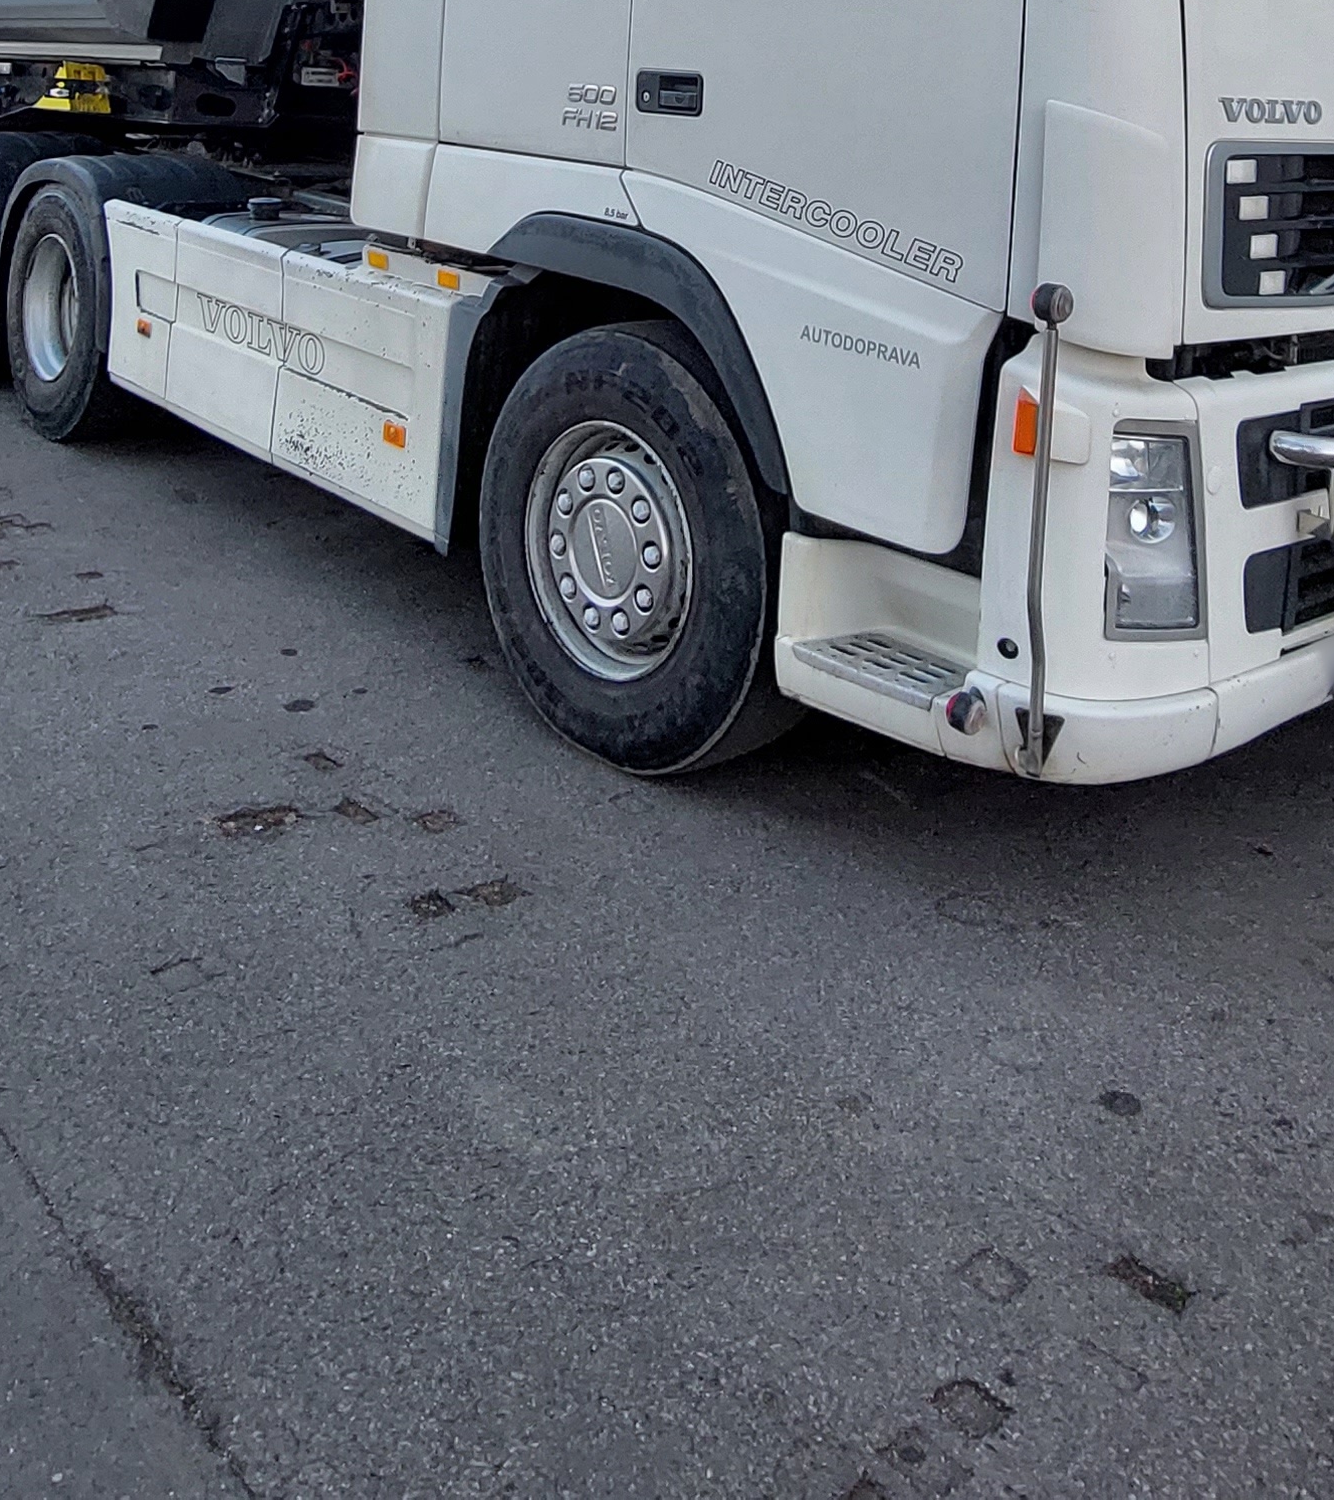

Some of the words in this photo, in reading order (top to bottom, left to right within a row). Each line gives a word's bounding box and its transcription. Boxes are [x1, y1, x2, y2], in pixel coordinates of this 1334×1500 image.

[568, 84, 617, 106] 500
[562, 107, 618, 131] FH12
[1218, 97, 1322, 125] VOLVO
[616, 210, 629, 220] bar
[709, 160, 964, 283] INTERCOOLER
[197, 293, 325, 375] VOLVO
[800, 325, 921, 369] AUTODOPRAVA
